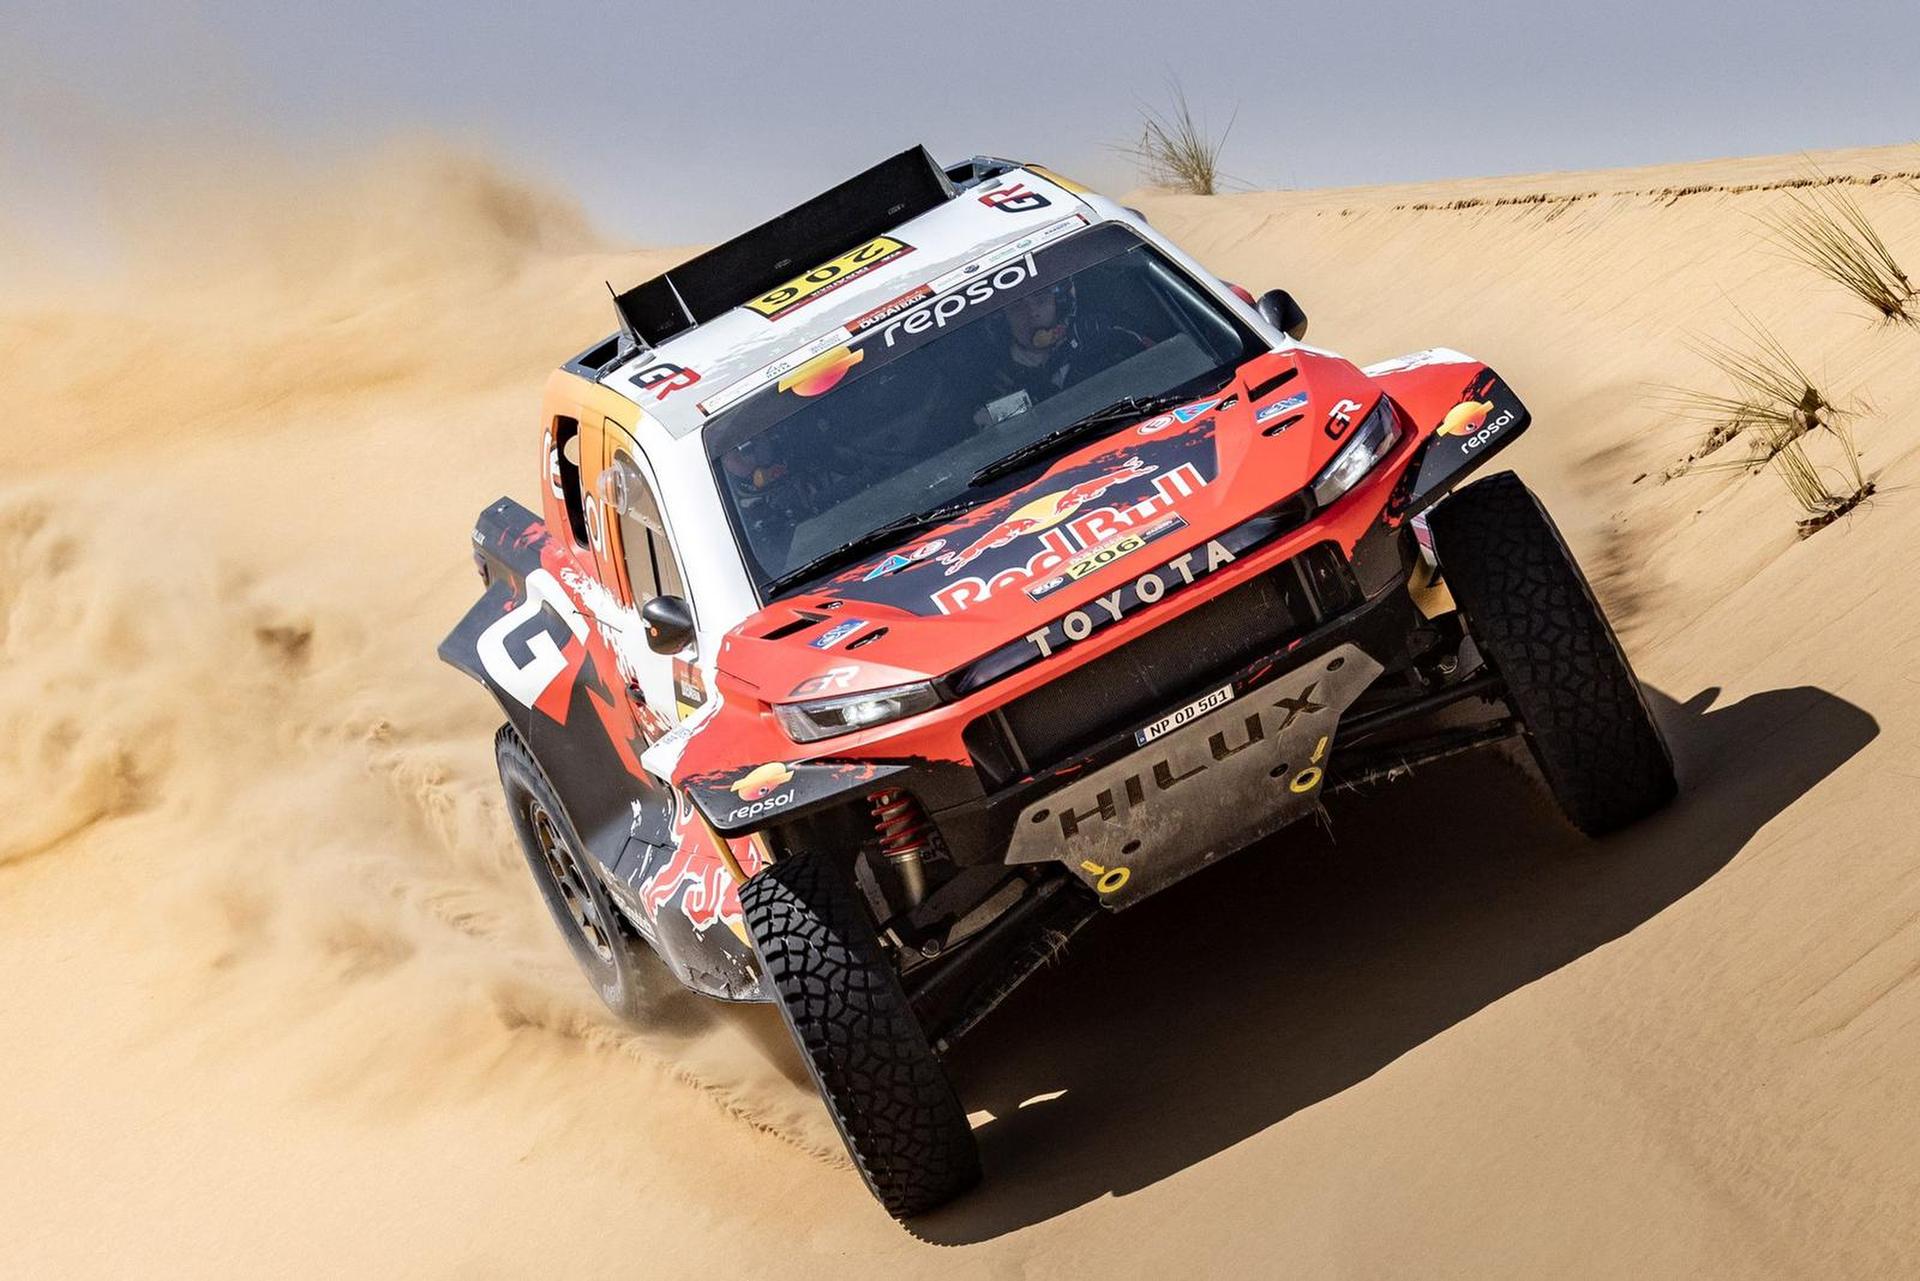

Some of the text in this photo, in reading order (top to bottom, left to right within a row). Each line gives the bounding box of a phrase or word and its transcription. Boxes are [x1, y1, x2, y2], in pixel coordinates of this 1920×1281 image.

[762, 244, 884, 305] 206
[884, 251, 1038, 347] repsol
[1324, 399, 1363, 441] GR
[1461, 410, 1515, 454] repsol
[930, 462, 1208, 615] Red Bull
[1072, 538, 1140, 577] 206
[1026, 540, 1236, 658] TOYOTA
[1150, 689, 1228, 738] NP OD 501
[1059, 680, 1328, 840] HILUX
[728, 789, 795, 822] repsol
